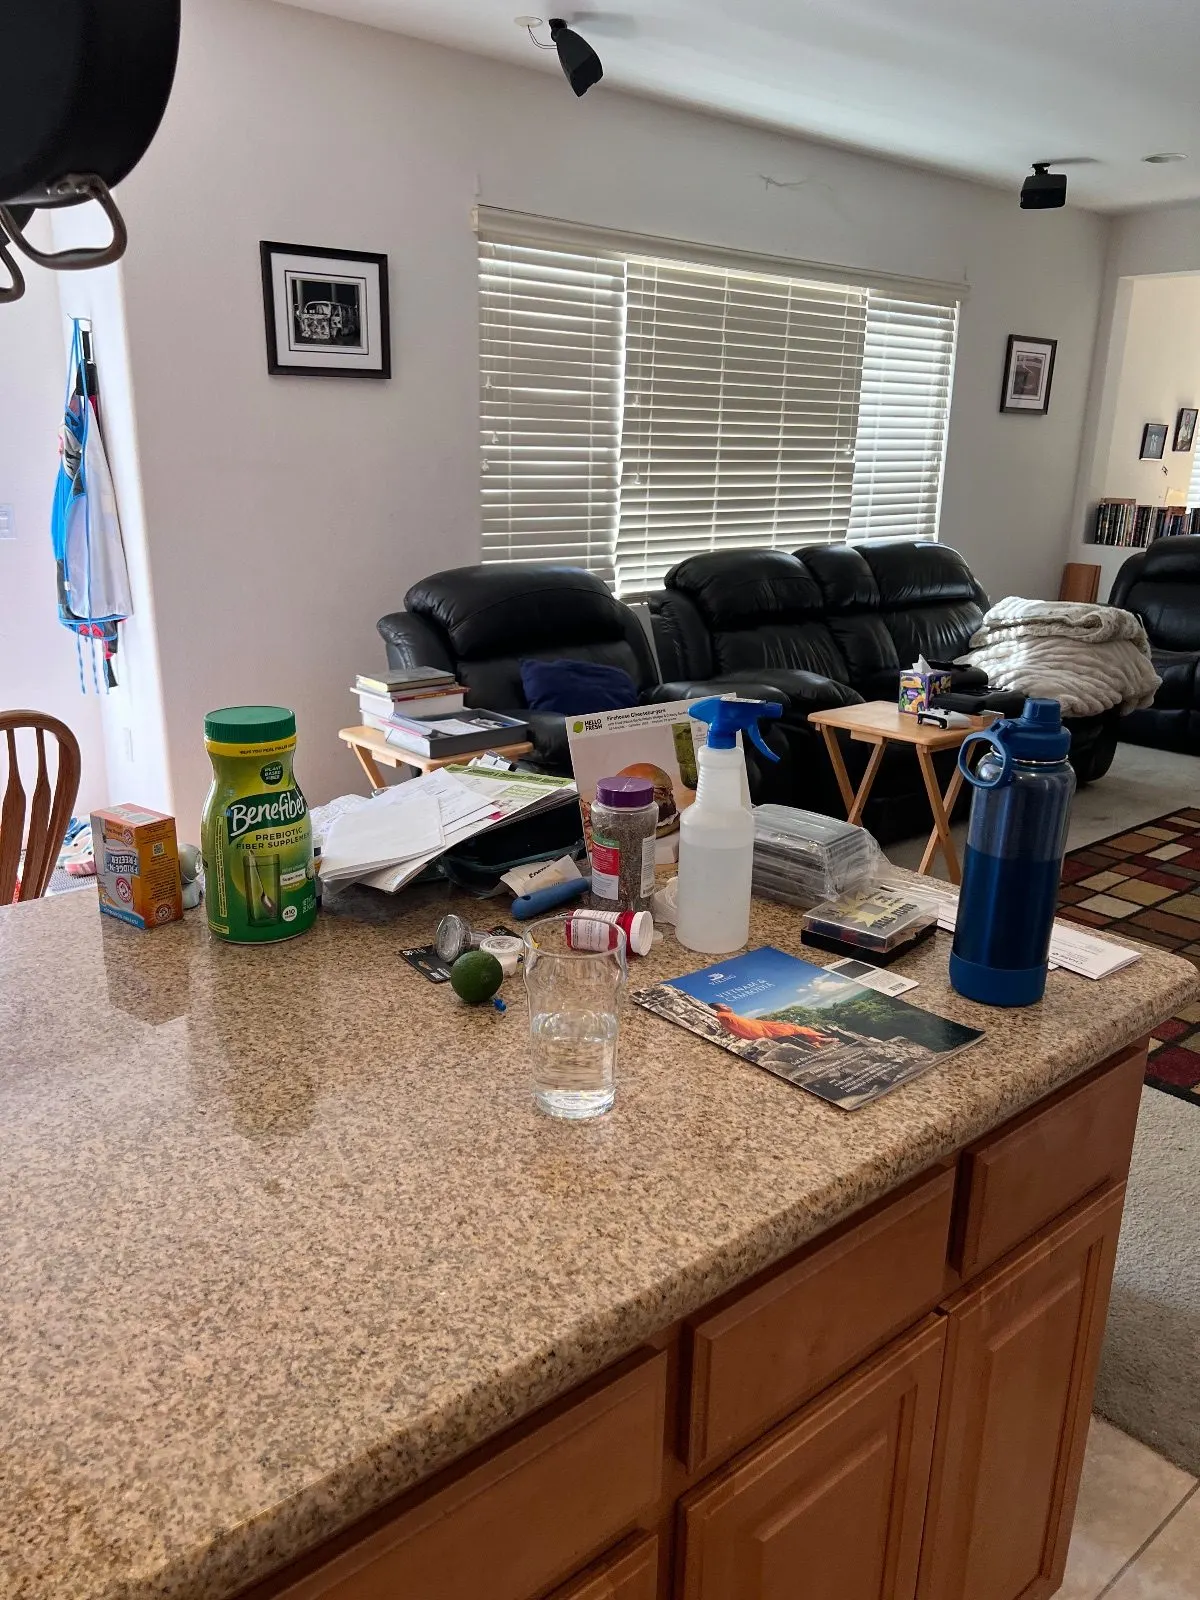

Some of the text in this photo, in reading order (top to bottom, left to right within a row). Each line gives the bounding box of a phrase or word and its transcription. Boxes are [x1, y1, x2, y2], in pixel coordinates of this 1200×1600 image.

[255, 827, 303, 841] PREBIOTIC
[111, 855, 137, 865] FREEZER
[715, 981, 758, 998] VIETNAM
[725, 982, 776, 1002] CAMBODIA
